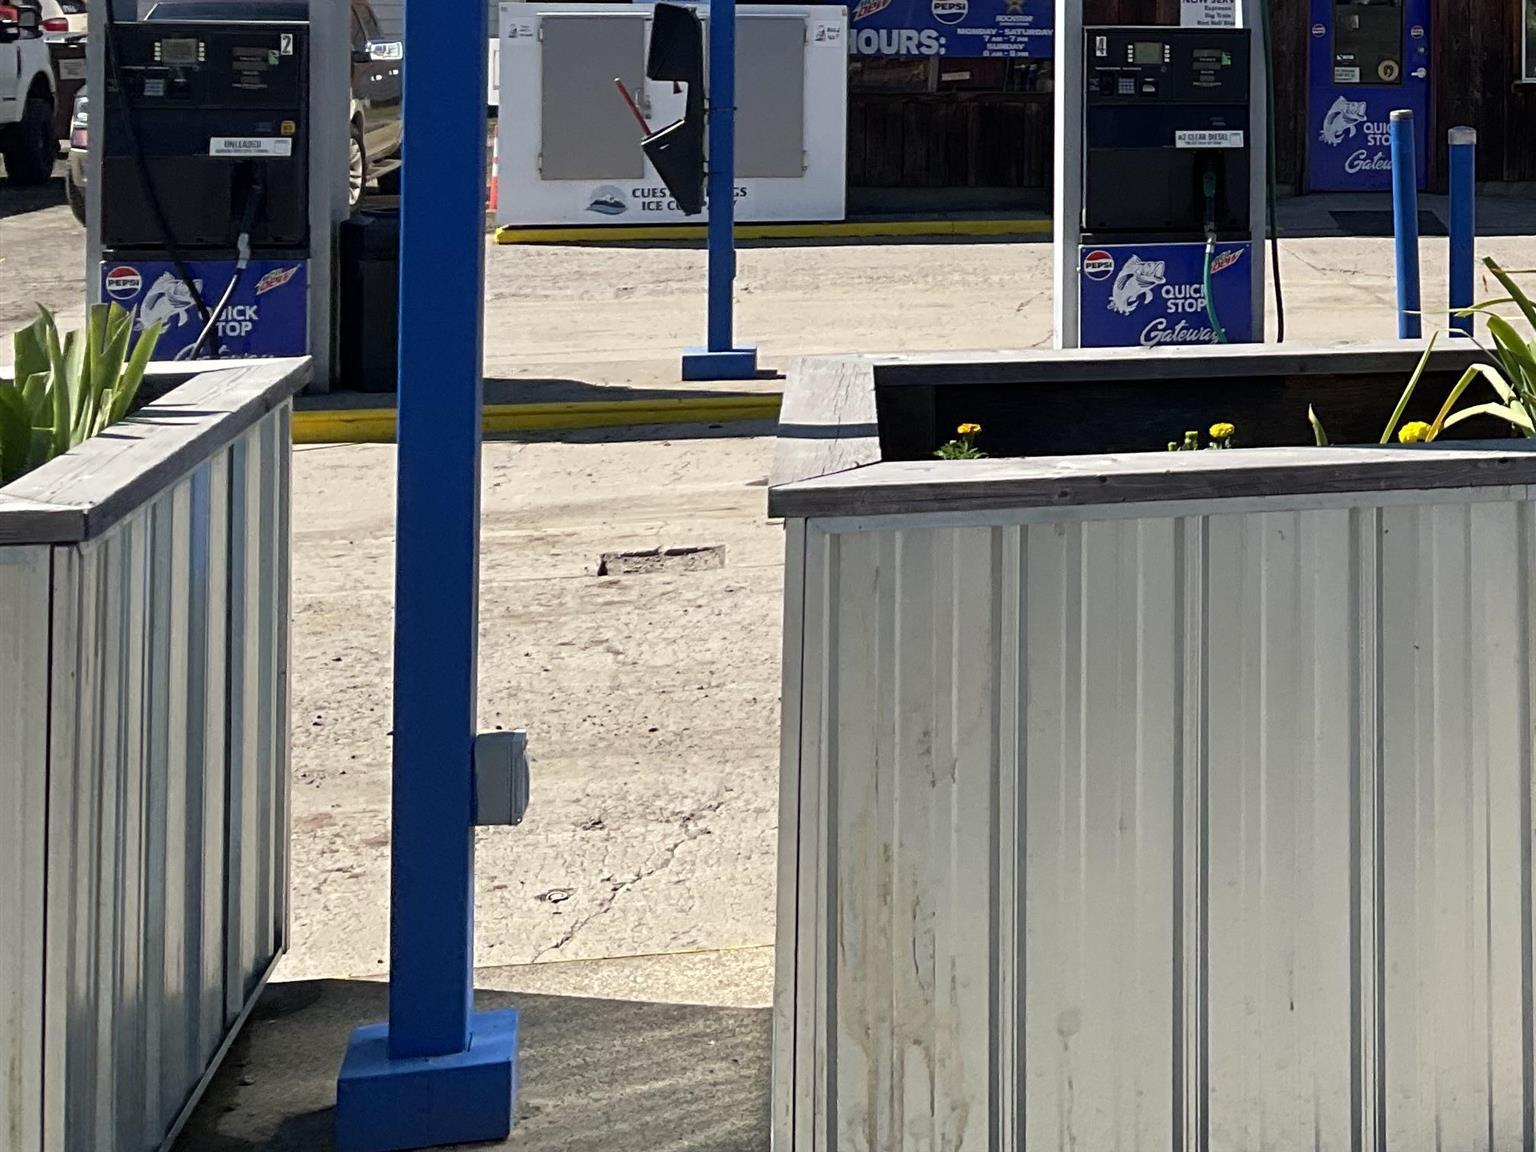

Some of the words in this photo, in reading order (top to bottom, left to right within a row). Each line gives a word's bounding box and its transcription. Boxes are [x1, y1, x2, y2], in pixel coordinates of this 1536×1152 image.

[934, 2, 966, 11] PEPSI
[282, 35, 291, 54] 2
[1363, 122, 1391, 134] QUI
[1367, 134, 1391, 145] STO
[632, 188, 667, 198] CUES
[642, 201, 663, 211] ICE
[1086, 261, 1112, 269] PEPSI
[108, 279, 140, 288] PEPSI
[1166, 298, 1206, 313] STOP
[216, 321, 252, 337] TOP
